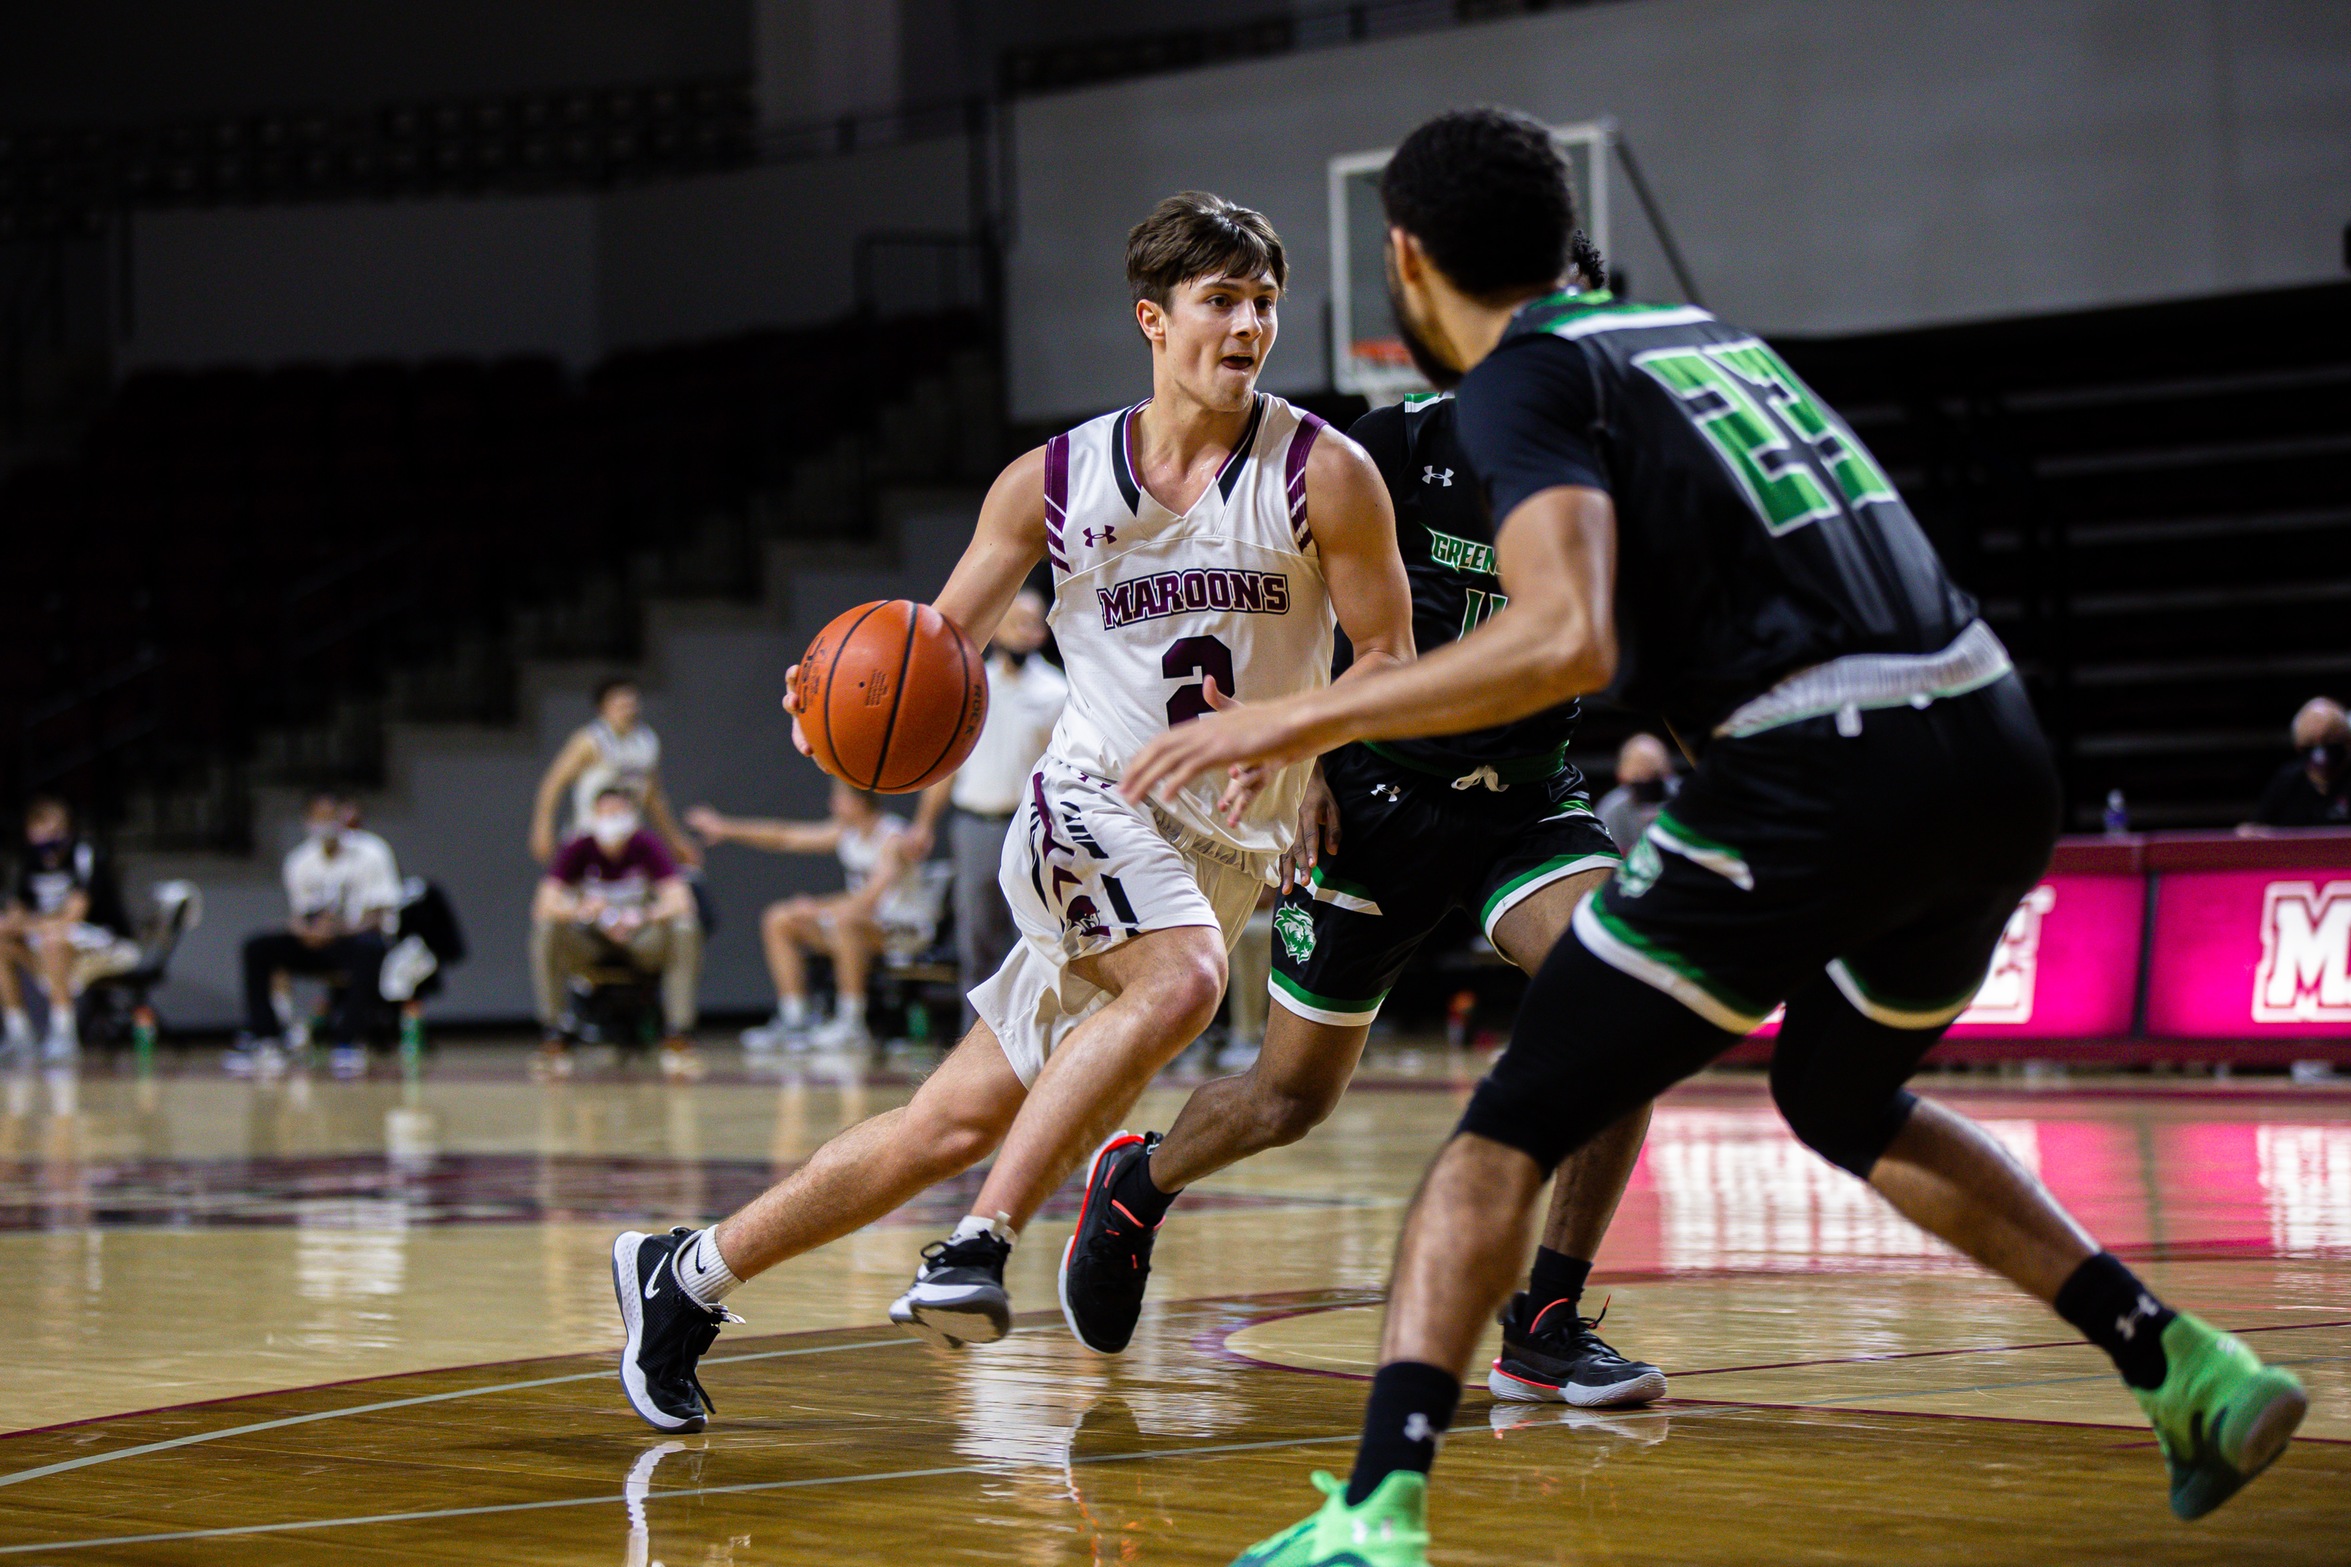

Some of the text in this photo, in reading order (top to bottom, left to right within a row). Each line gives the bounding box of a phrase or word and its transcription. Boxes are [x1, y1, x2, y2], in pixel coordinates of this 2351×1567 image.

[1630, 336, 1899, 538] 23
[1420, 523, 1504, 576] GREEN
[1096, 567, 1290, 631] MAROONS
[1161, 634, 1236, 731] 2
